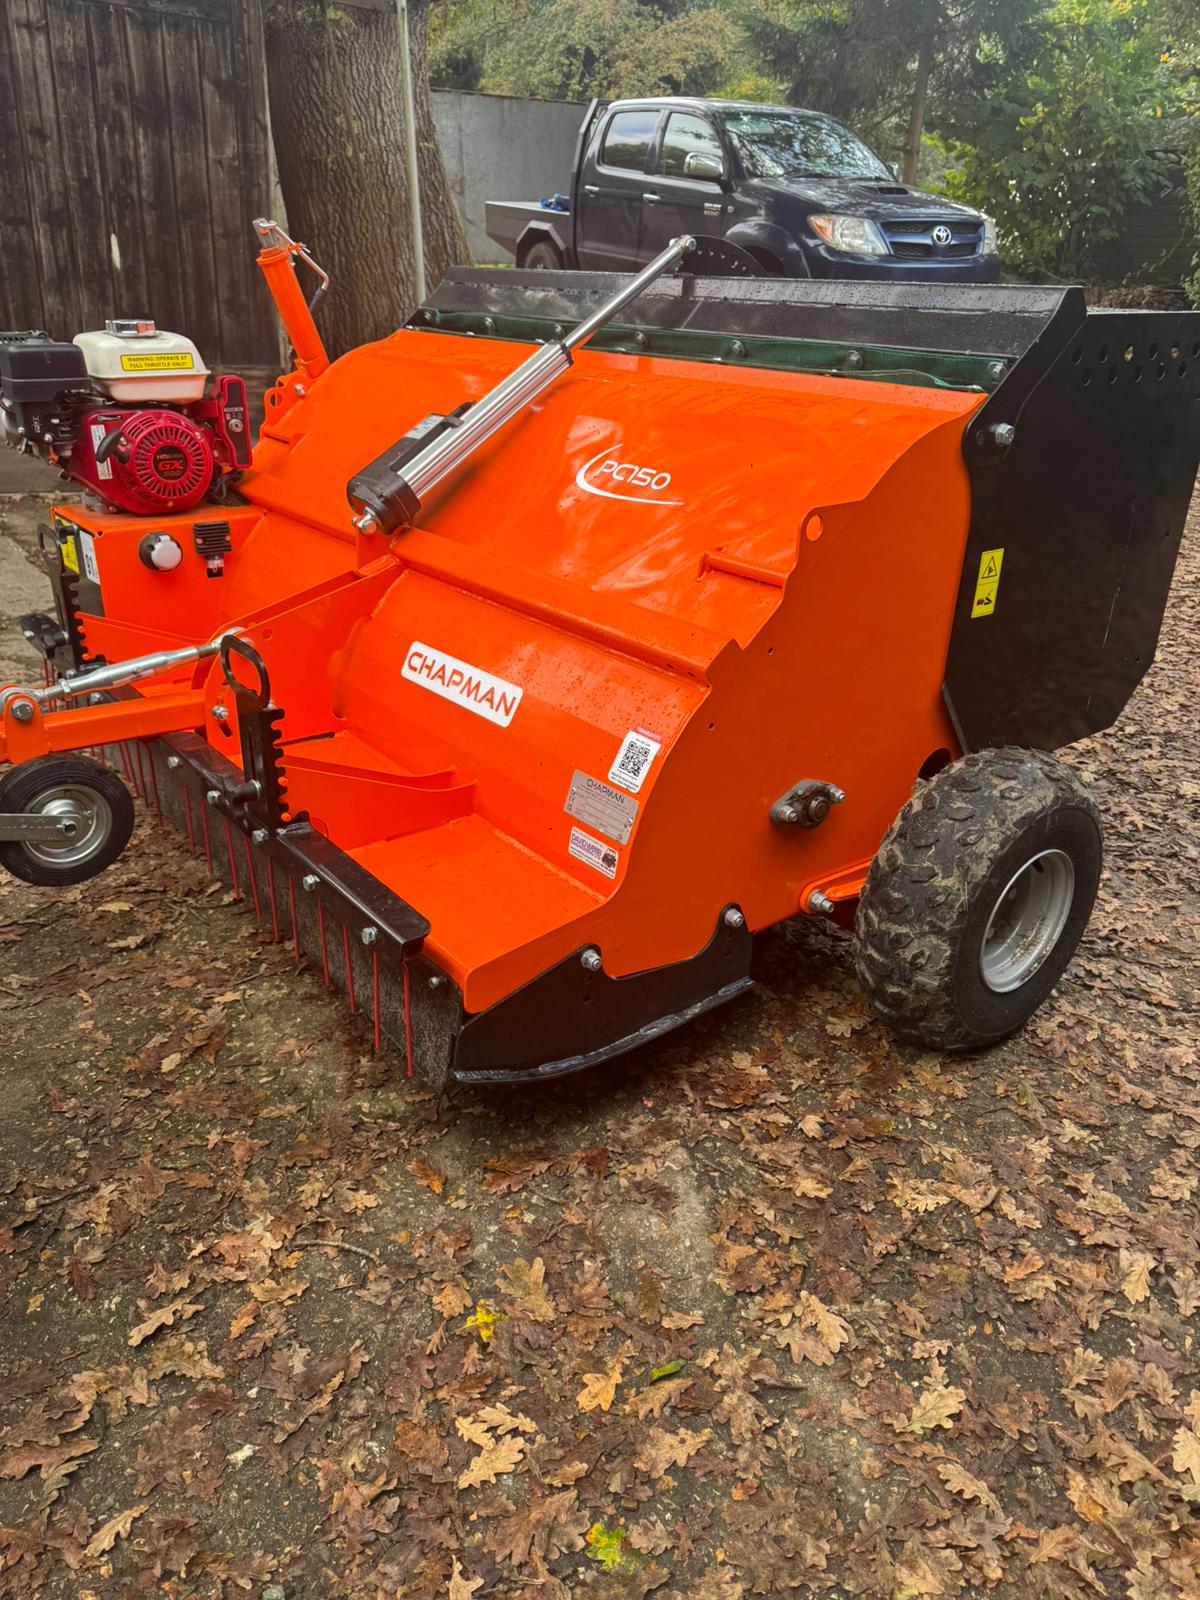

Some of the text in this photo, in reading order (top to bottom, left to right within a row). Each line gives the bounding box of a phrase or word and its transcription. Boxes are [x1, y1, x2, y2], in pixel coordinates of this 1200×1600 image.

[158, 460, 184, 470] GX
[594, 459, 671, 490] PC150
[407, 651, 516, 717] CHAPMAN
[586, 778, 625, 804] CHAPMAN
